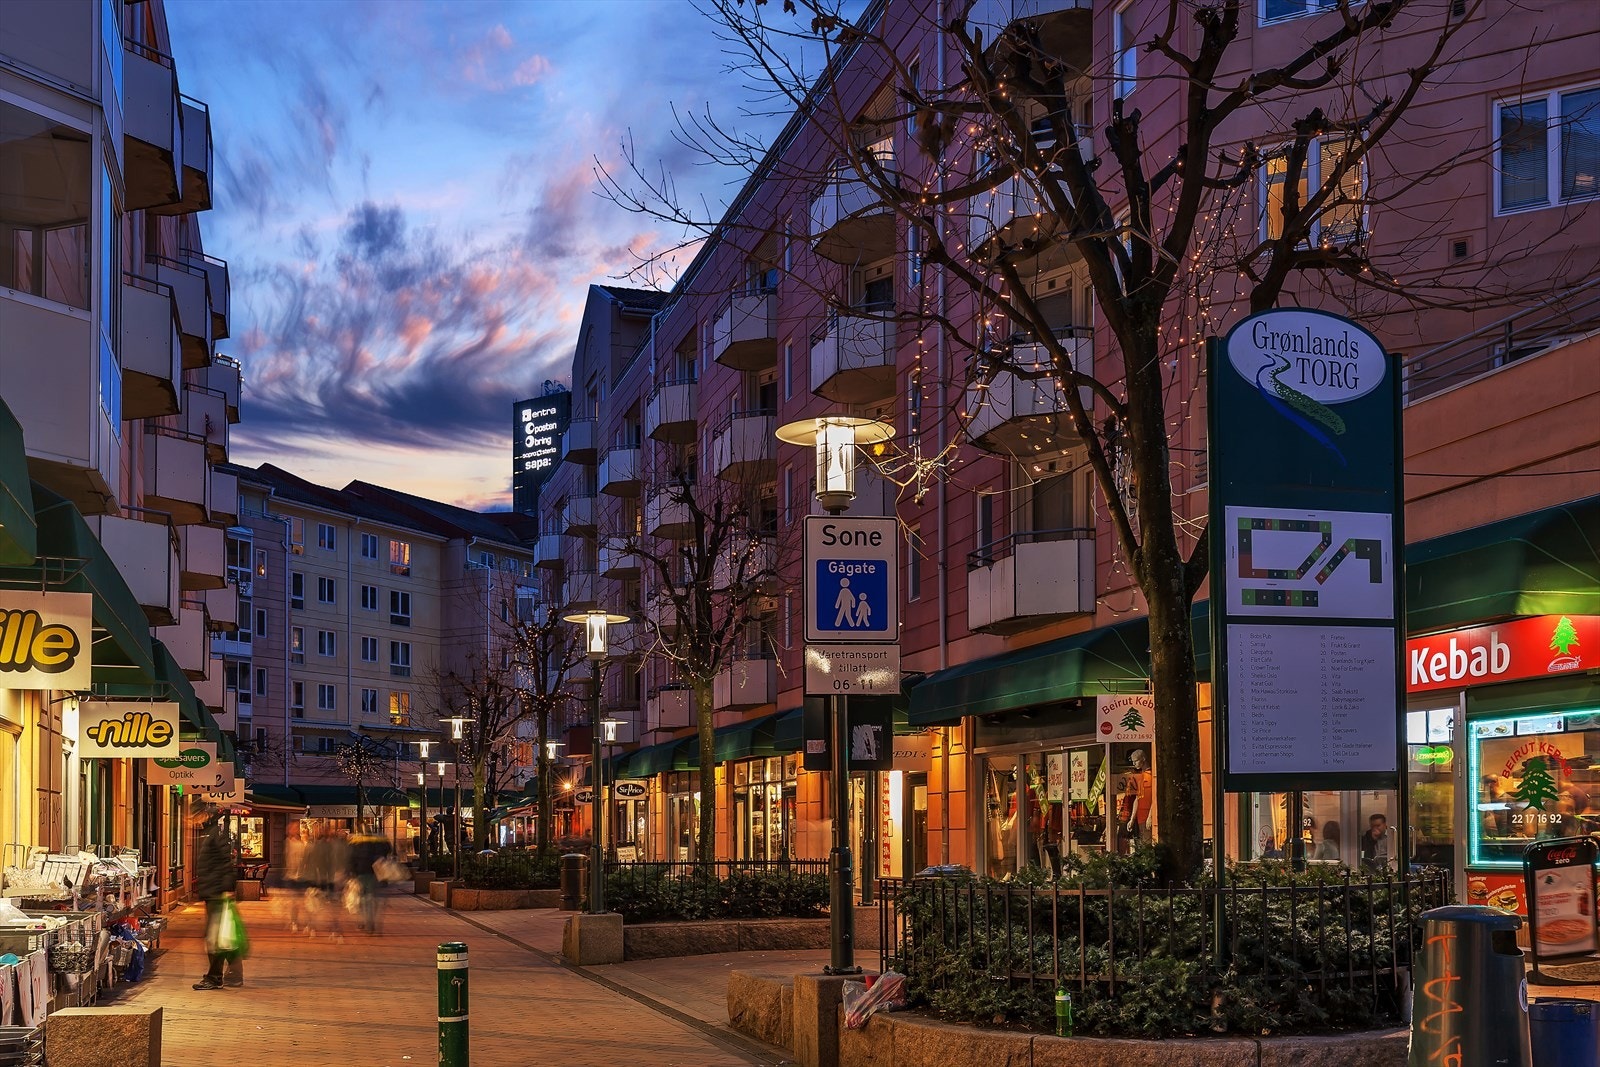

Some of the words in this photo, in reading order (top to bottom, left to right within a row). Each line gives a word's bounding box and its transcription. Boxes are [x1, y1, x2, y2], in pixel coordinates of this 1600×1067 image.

[1252, 320, 1359, 360] Grønlands
[1296, 358, 1359, 390] TORG
[532, 408, 556, 418] entra
[534, 422, 556, 434] posten
[534, 436, 551, 446] bring
[822, 525, 882, 546] Sone
[829, 561, 876, 576] Gågate
[1411, 631, 1511, 685] Kebab
[1102, 696, 1133, 714] Beirut
[1502, 742, 1535, 779] BEIRUT
[1539, 741, 1572, 777] KEBAB
[169, 771, 194, 779] Optikk
[1090, 770, 1106, 805] SALG
[1304, 818, 1311, 826] 92
[1512, 814, 1522, 824] 22
[1526, 814, 1534, 824] 17
[1537, 814, 1547, 823] 16
[1550, 814, 1562, 823] 92
